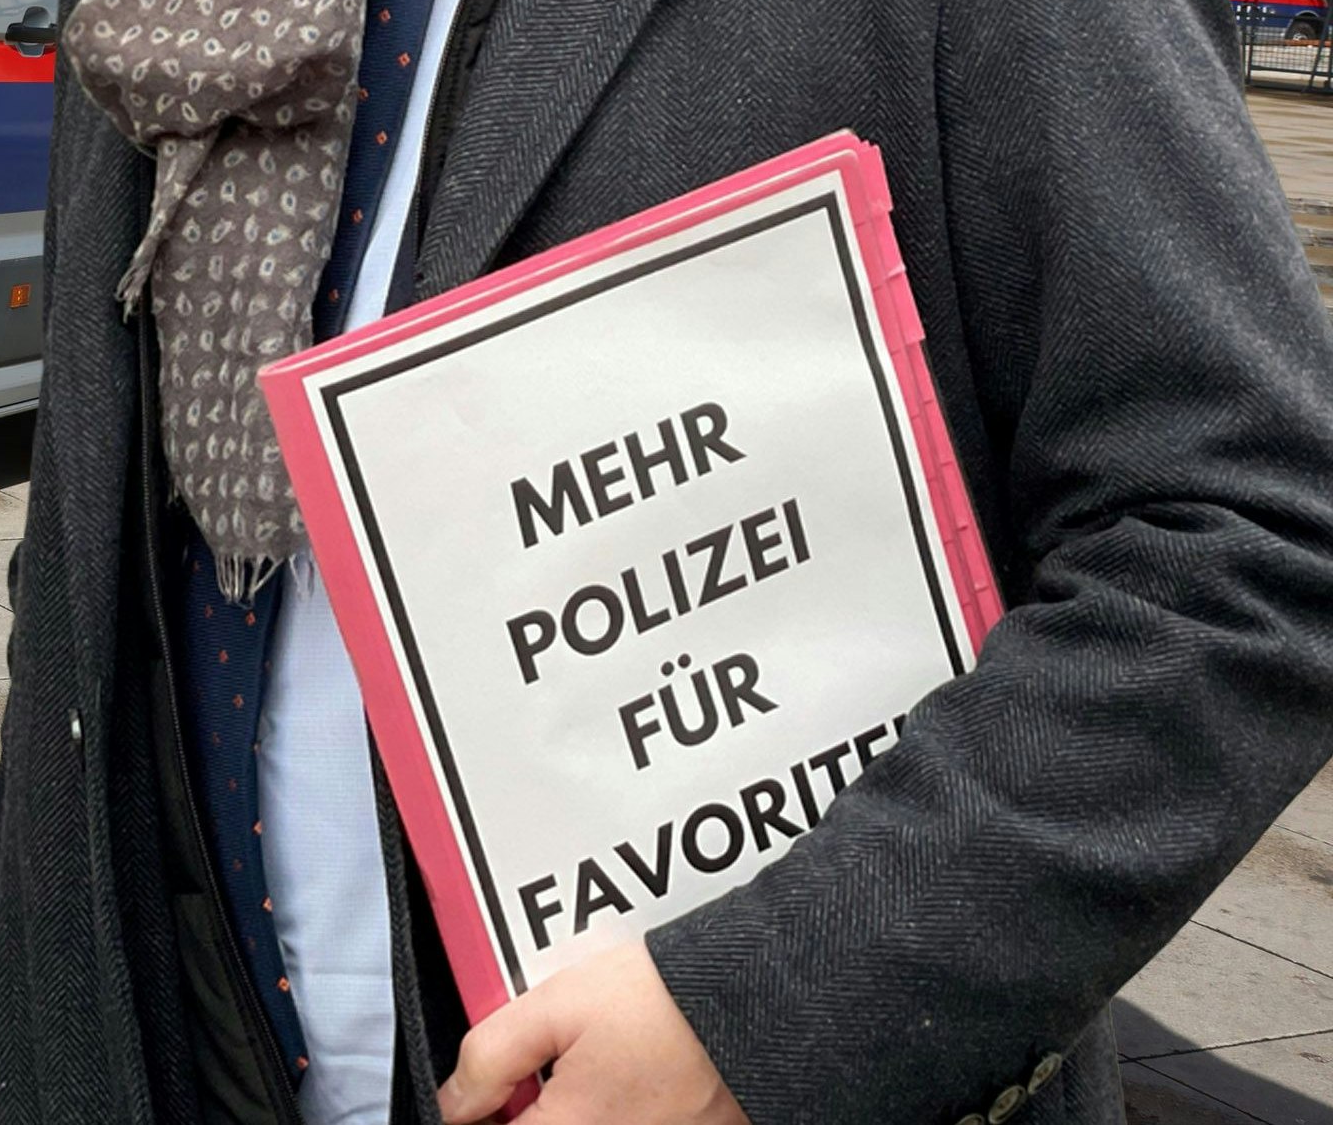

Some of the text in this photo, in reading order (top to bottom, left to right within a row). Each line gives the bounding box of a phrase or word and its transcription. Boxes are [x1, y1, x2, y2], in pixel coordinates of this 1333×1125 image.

[510, 401, 747, 549] MEHR
[505, 498, 811, 686] POLIZEI
[618, 652, 779, 771] FÜR
[518, 713, 908, 951] FAVORIT
